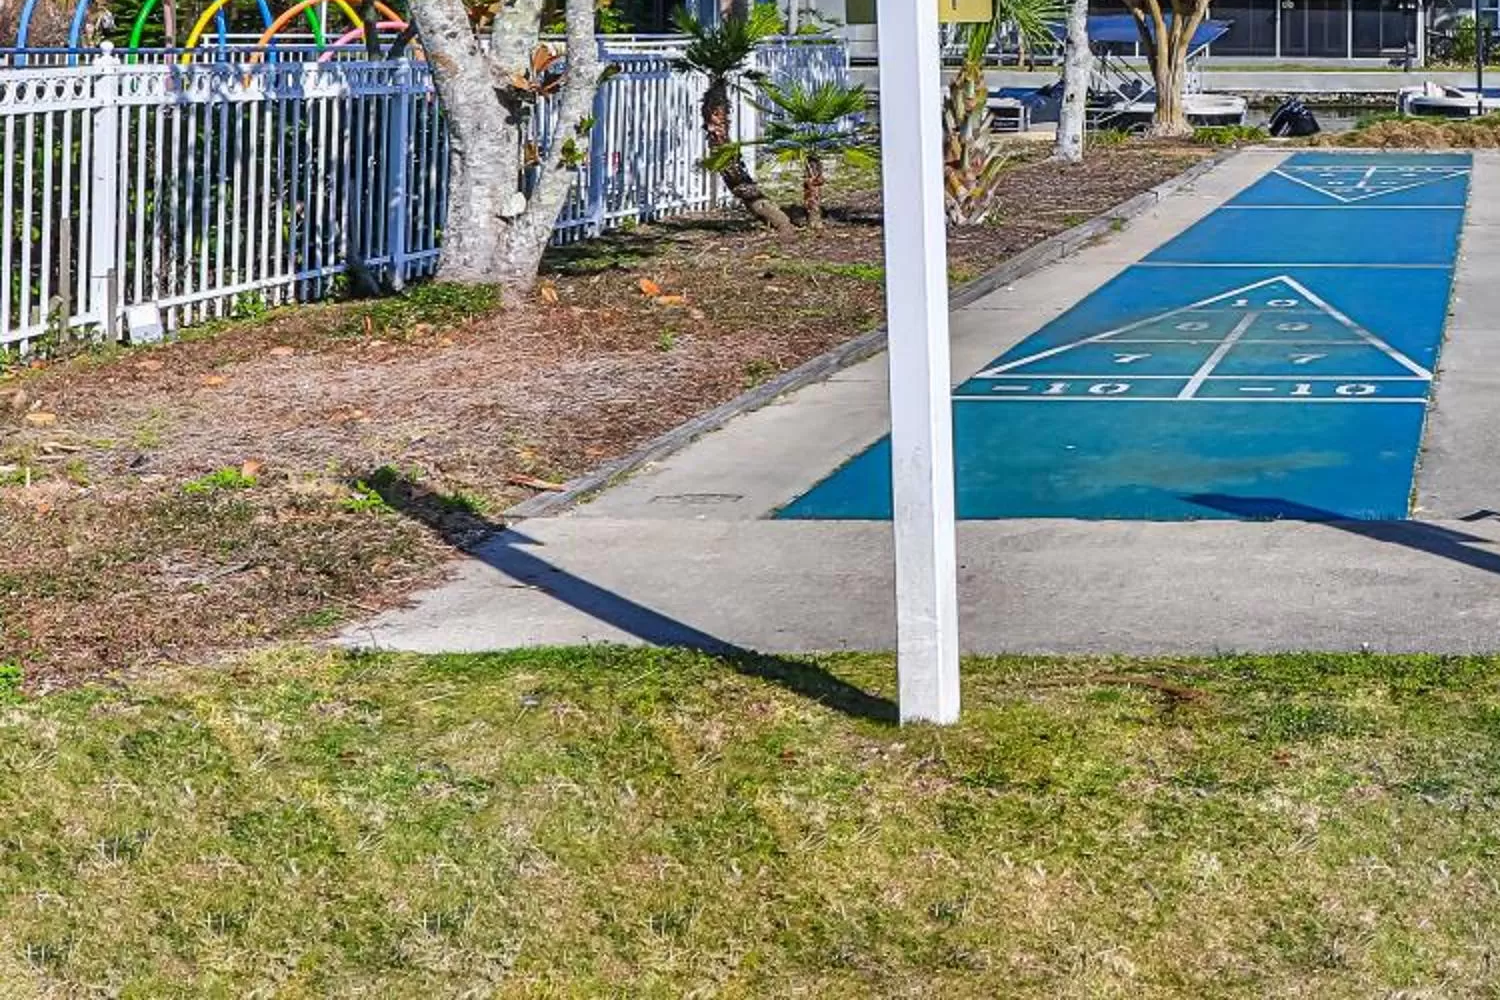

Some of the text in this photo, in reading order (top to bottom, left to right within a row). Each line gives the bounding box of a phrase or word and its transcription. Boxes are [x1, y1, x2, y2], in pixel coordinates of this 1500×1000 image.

[1231, 299, 1299, 307] 10
[1113, 353, 1153, 364] 7
[1290, 353, 1329, 364] 7
